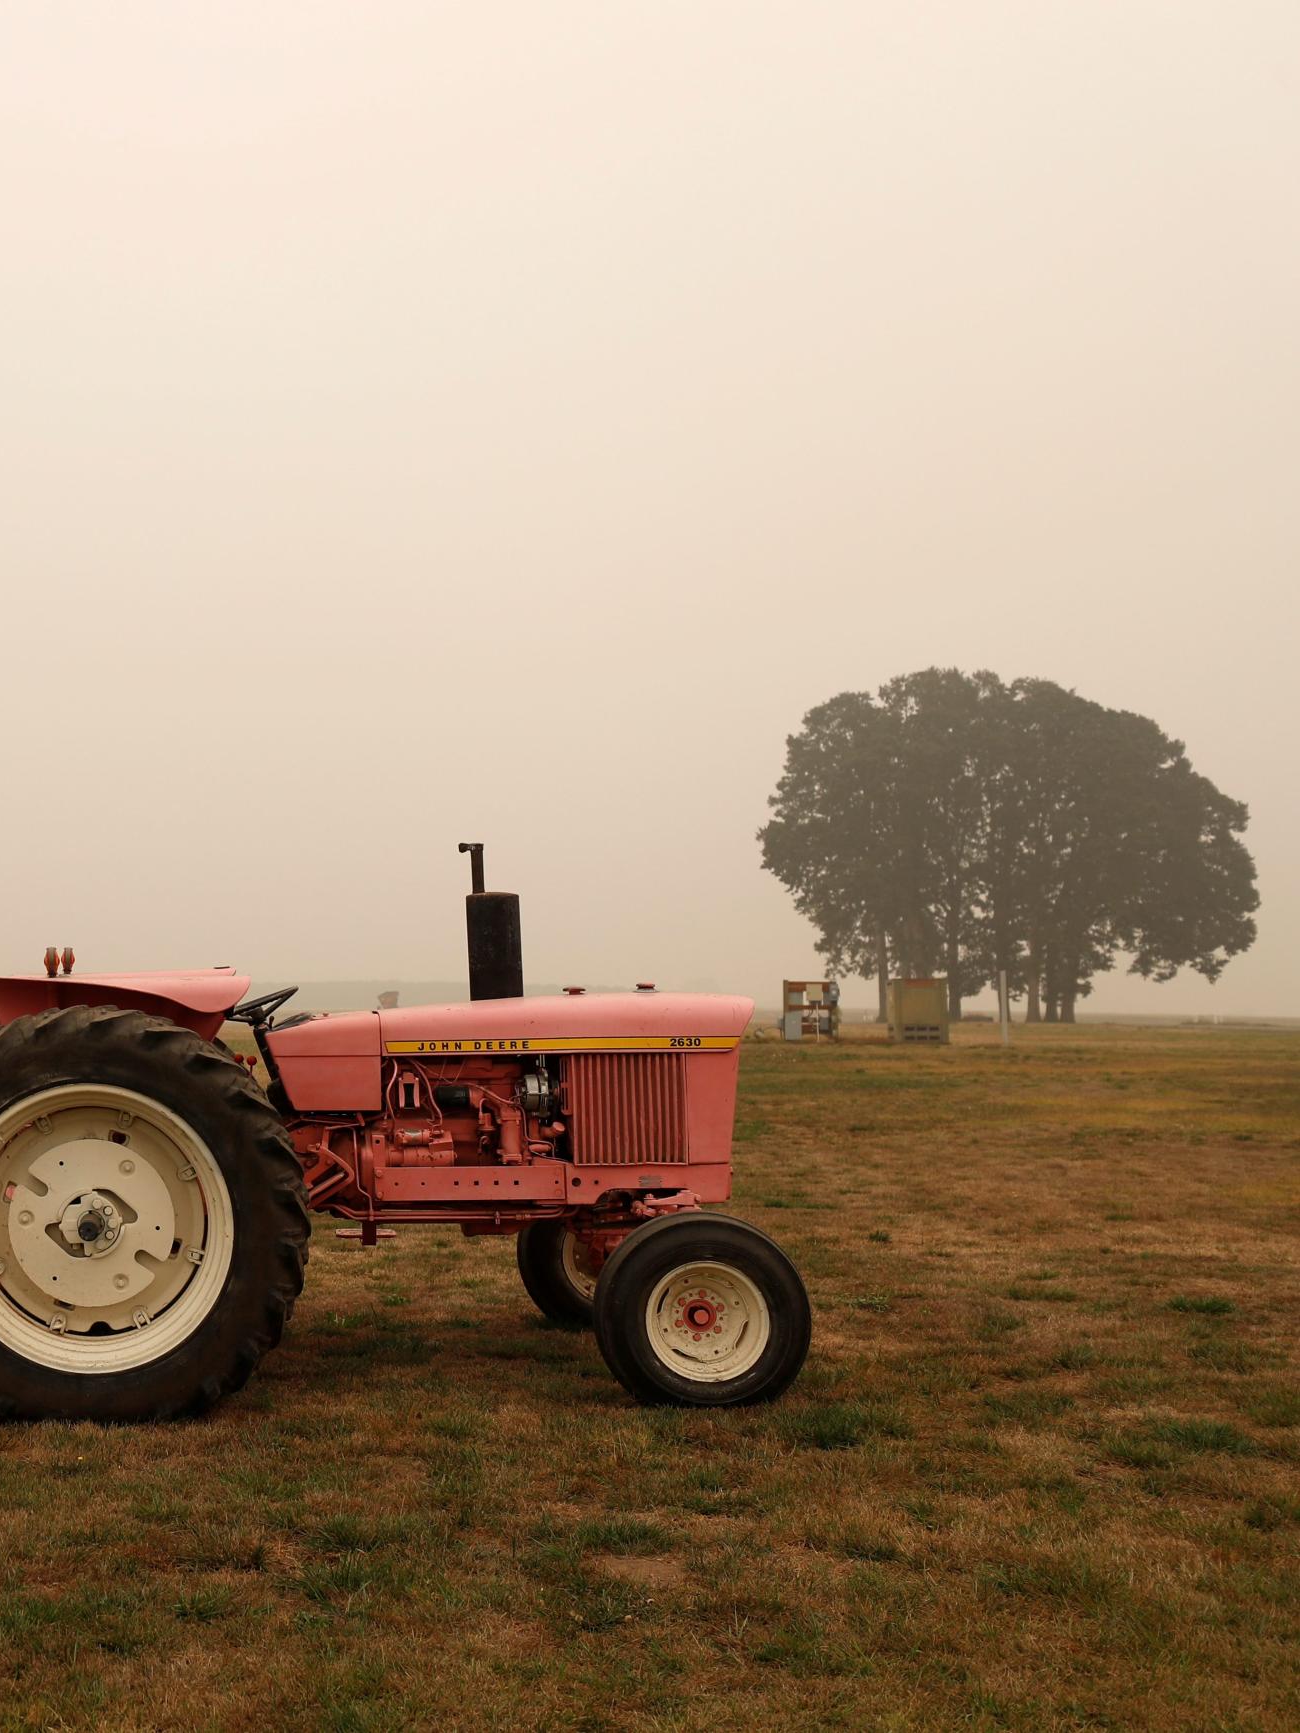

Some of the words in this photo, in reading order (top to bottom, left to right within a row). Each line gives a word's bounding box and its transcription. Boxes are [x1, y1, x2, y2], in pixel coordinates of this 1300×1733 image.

[418, 1041, 462, 1051] JOHN
[474, 1040, 529, 1050] DEERE
[669, 1038, 702, 1047] 2630
